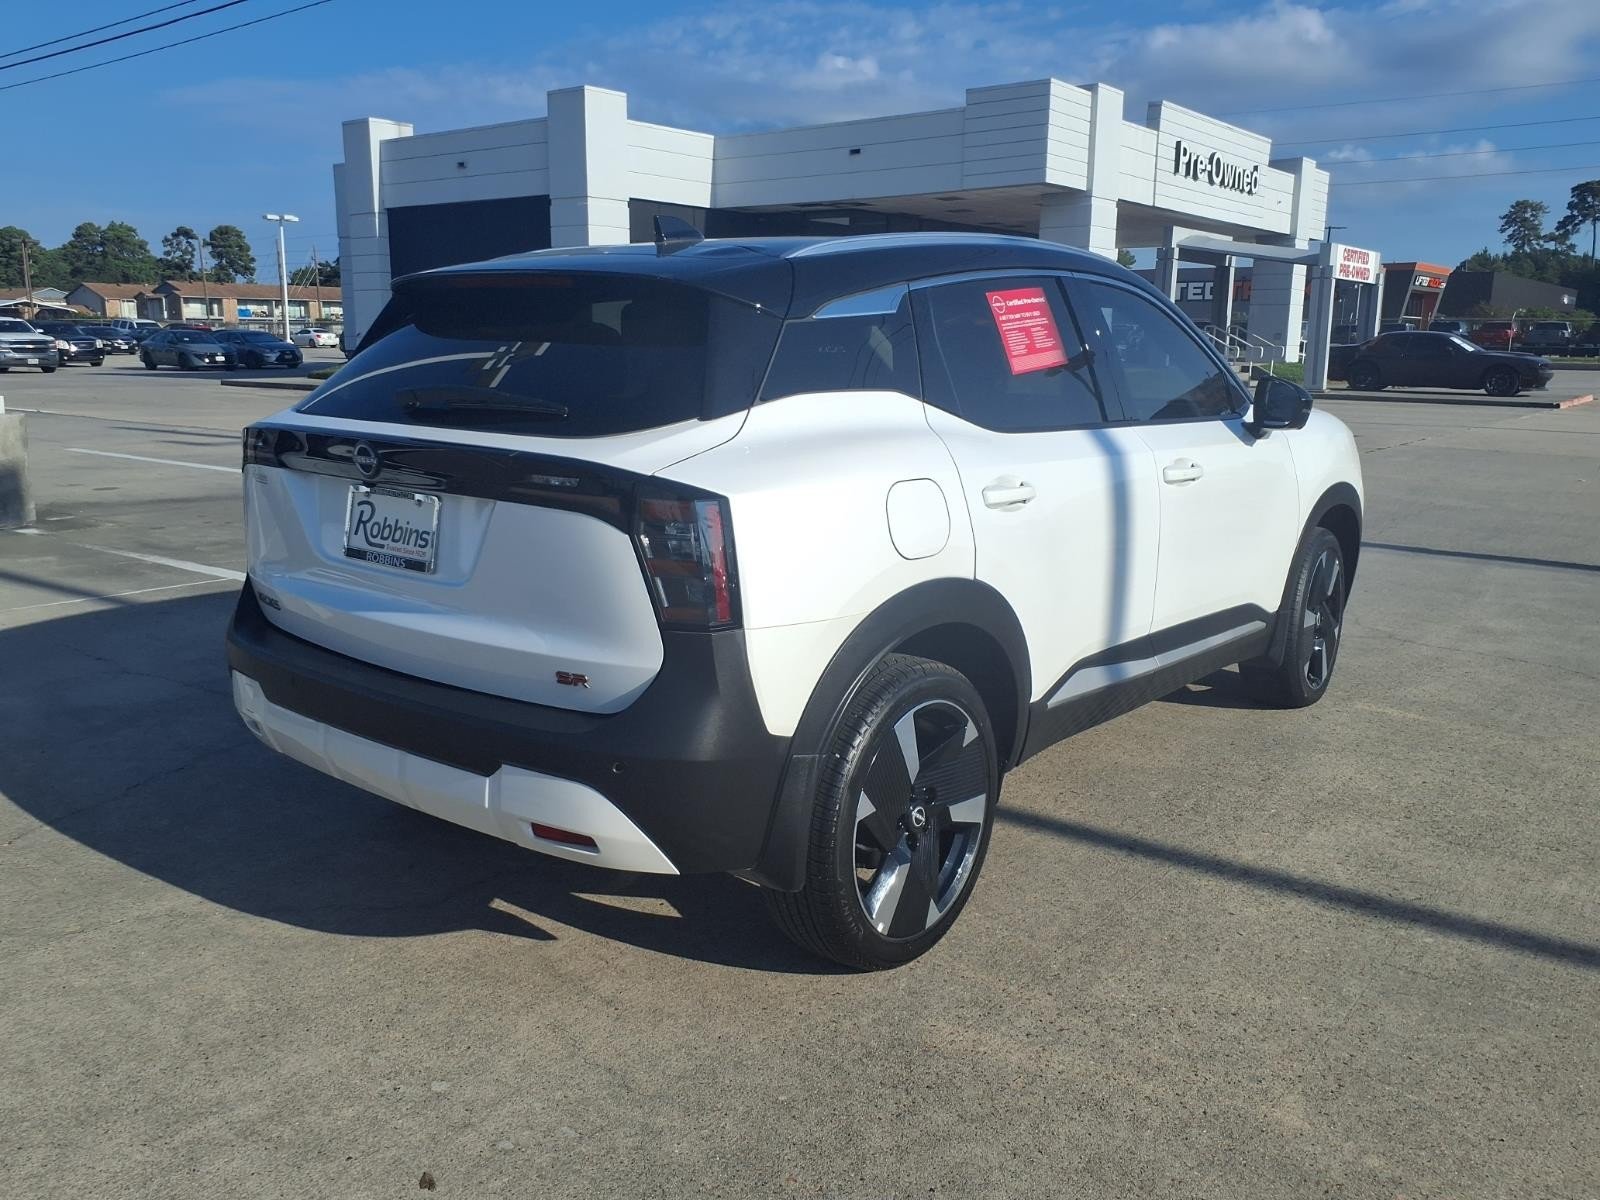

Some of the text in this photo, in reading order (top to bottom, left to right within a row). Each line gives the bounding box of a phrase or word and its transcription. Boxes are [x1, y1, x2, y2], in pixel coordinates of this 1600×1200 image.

[1174, 141, 1258, 195] Pre-Owned
[1343, 248, 1369, 265] CERTIFIED
[1338, 263, 1371, 280] PRE-OWNED
[354, 500, 430, 549] Robbins
[366, 551, 406, 568] ROBBINS
[555, 671, 591, 690] SR
